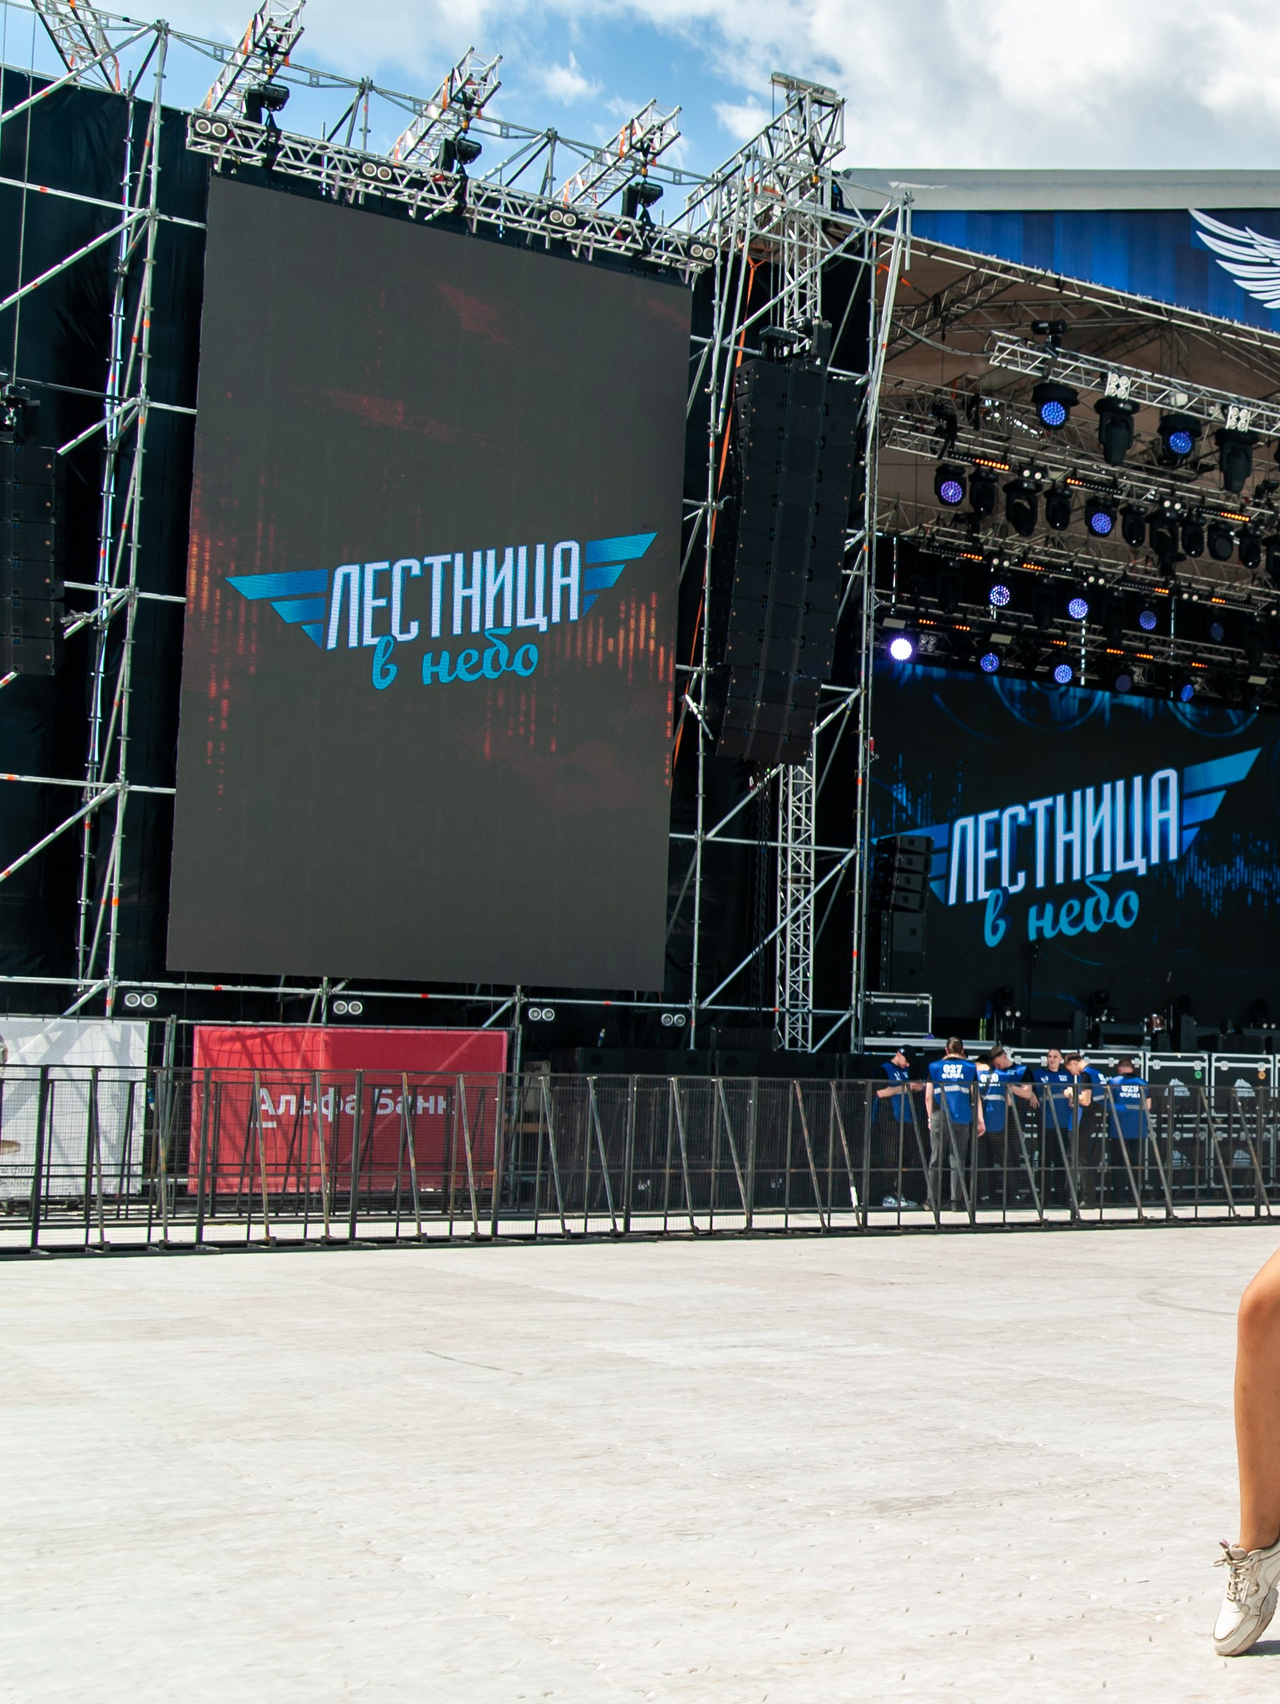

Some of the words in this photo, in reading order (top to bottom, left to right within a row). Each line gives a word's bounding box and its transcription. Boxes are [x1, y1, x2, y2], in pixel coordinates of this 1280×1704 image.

[326, 540, 580, 650] ЛЕСТНИЦА
[372, 636, 398, 690] в
[422, 627, 539, 685] небо
[948, 768, 1179, 906] ЛЕСТНИЦА
[984, 887, 1006, 947] в
[1028, 873, 1139, 941] небо
